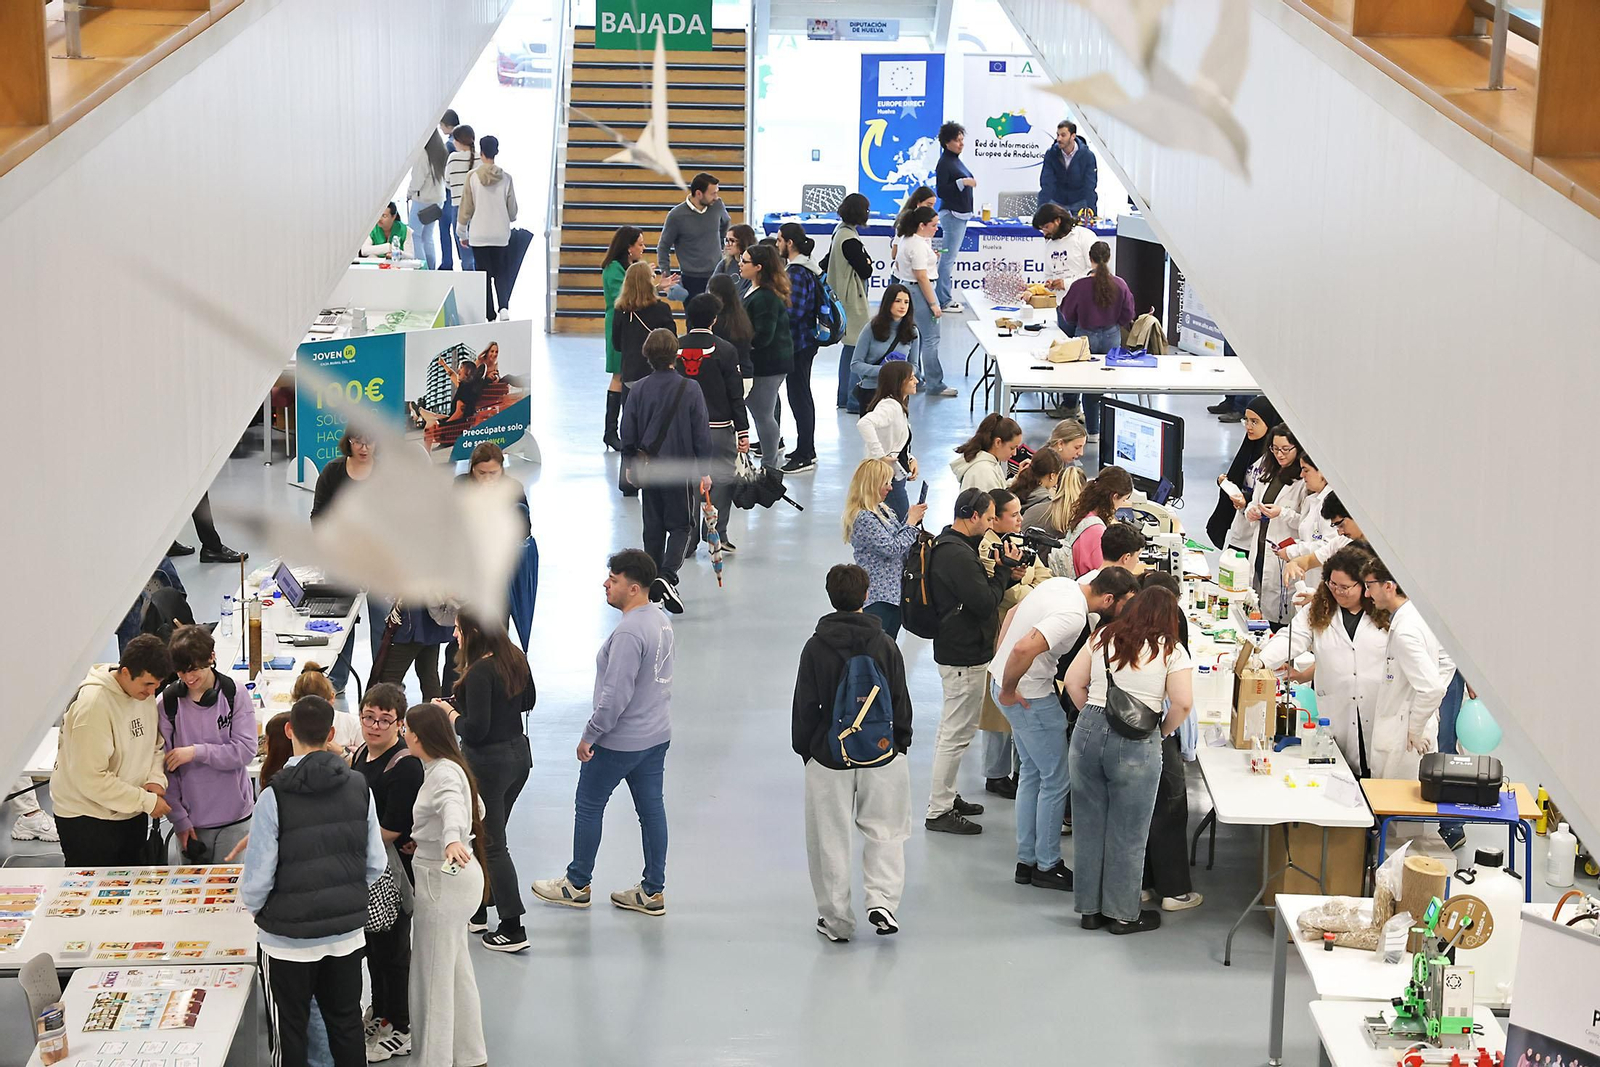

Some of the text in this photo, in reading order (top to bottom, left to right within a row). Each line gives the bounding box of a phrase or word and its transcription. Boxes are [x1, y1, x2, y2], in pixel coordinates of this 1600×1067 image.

[601, 12, 706, 35] BAJADA
[975, 139, 1039, 149] Red de Información
[1003, 150, 1011, 158] de
[312, 350, 343, 361] JOVEN
[462, 422, 523, 437] Preocúpate solo
[462, 440, 473, 448] de
